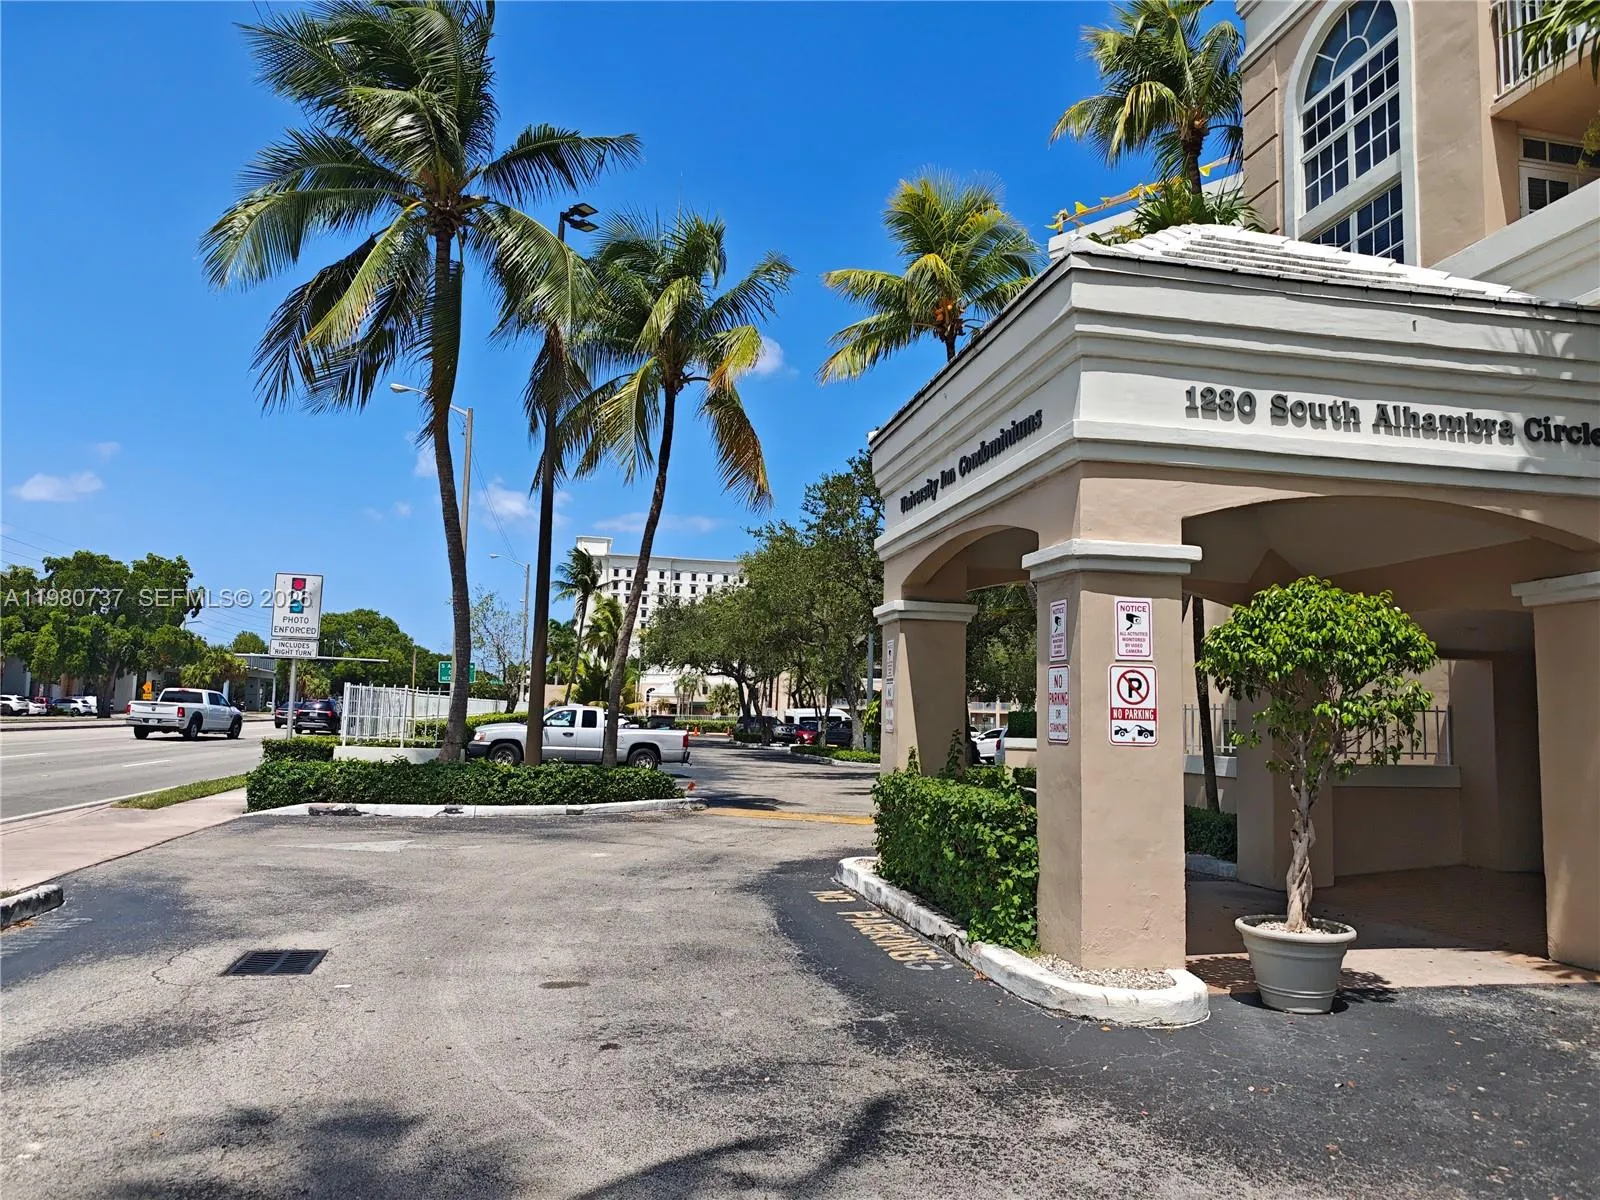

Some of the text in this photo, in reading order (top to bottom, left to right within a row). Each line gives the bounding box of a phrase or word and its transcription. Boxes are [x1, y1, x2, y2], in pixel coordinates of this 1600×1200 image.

[1270, 393, 1361, 424] South
[1373, 403, 1516, 437] Alhambra
[1524, 415, 1600, 446] Circle
[900, 409, 1042, 514] University Inn Condominiums
[282, 616, 310, 624] PHOTO
[274, 626, 316, 634] ENFORCED
[1054, 674, 1062, 688] NO
[1113, 708, 1154, 720] NO PARKING
[836, 910, 940, 961] PARKING
